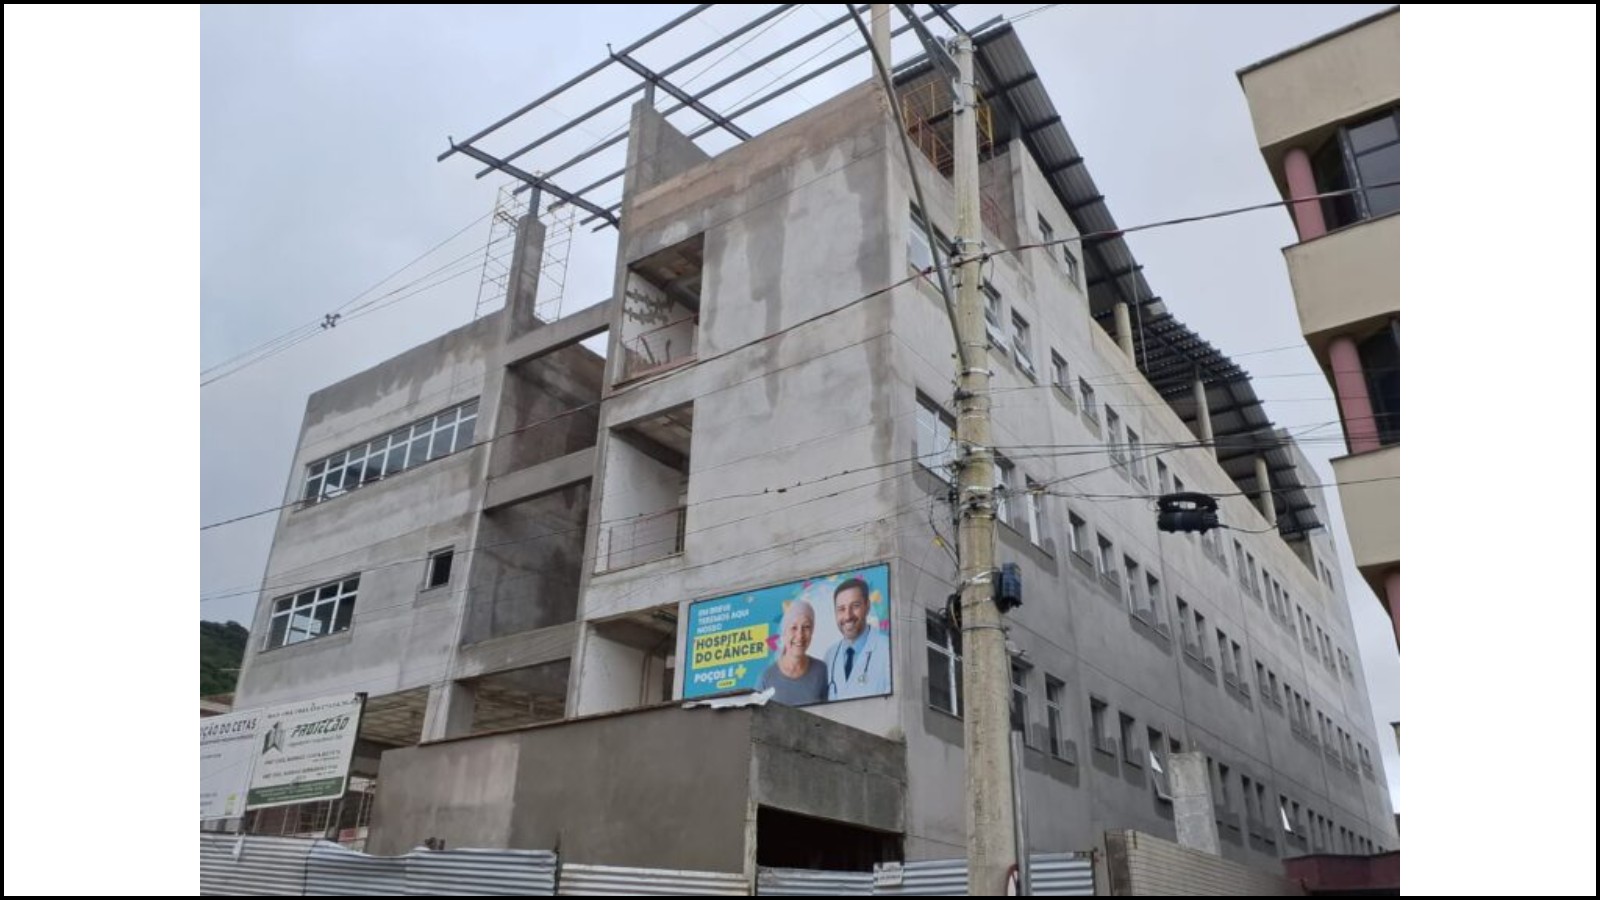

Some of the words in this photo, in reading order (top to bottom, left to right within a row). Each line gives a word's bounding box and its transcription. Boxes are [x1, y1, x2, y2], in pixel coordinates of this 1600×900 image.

[732, 608, 750, 618] AQUI
[696, 630, 753, 651] HOSPITAL
[695, 651, 712, 664] DO
[714, 641, 764, 660] CÂNCER
[694, 669, 726, 683] POÇOS
[218, 722, 231, 735] DO
[232, 718, 257, 734] CETAS
